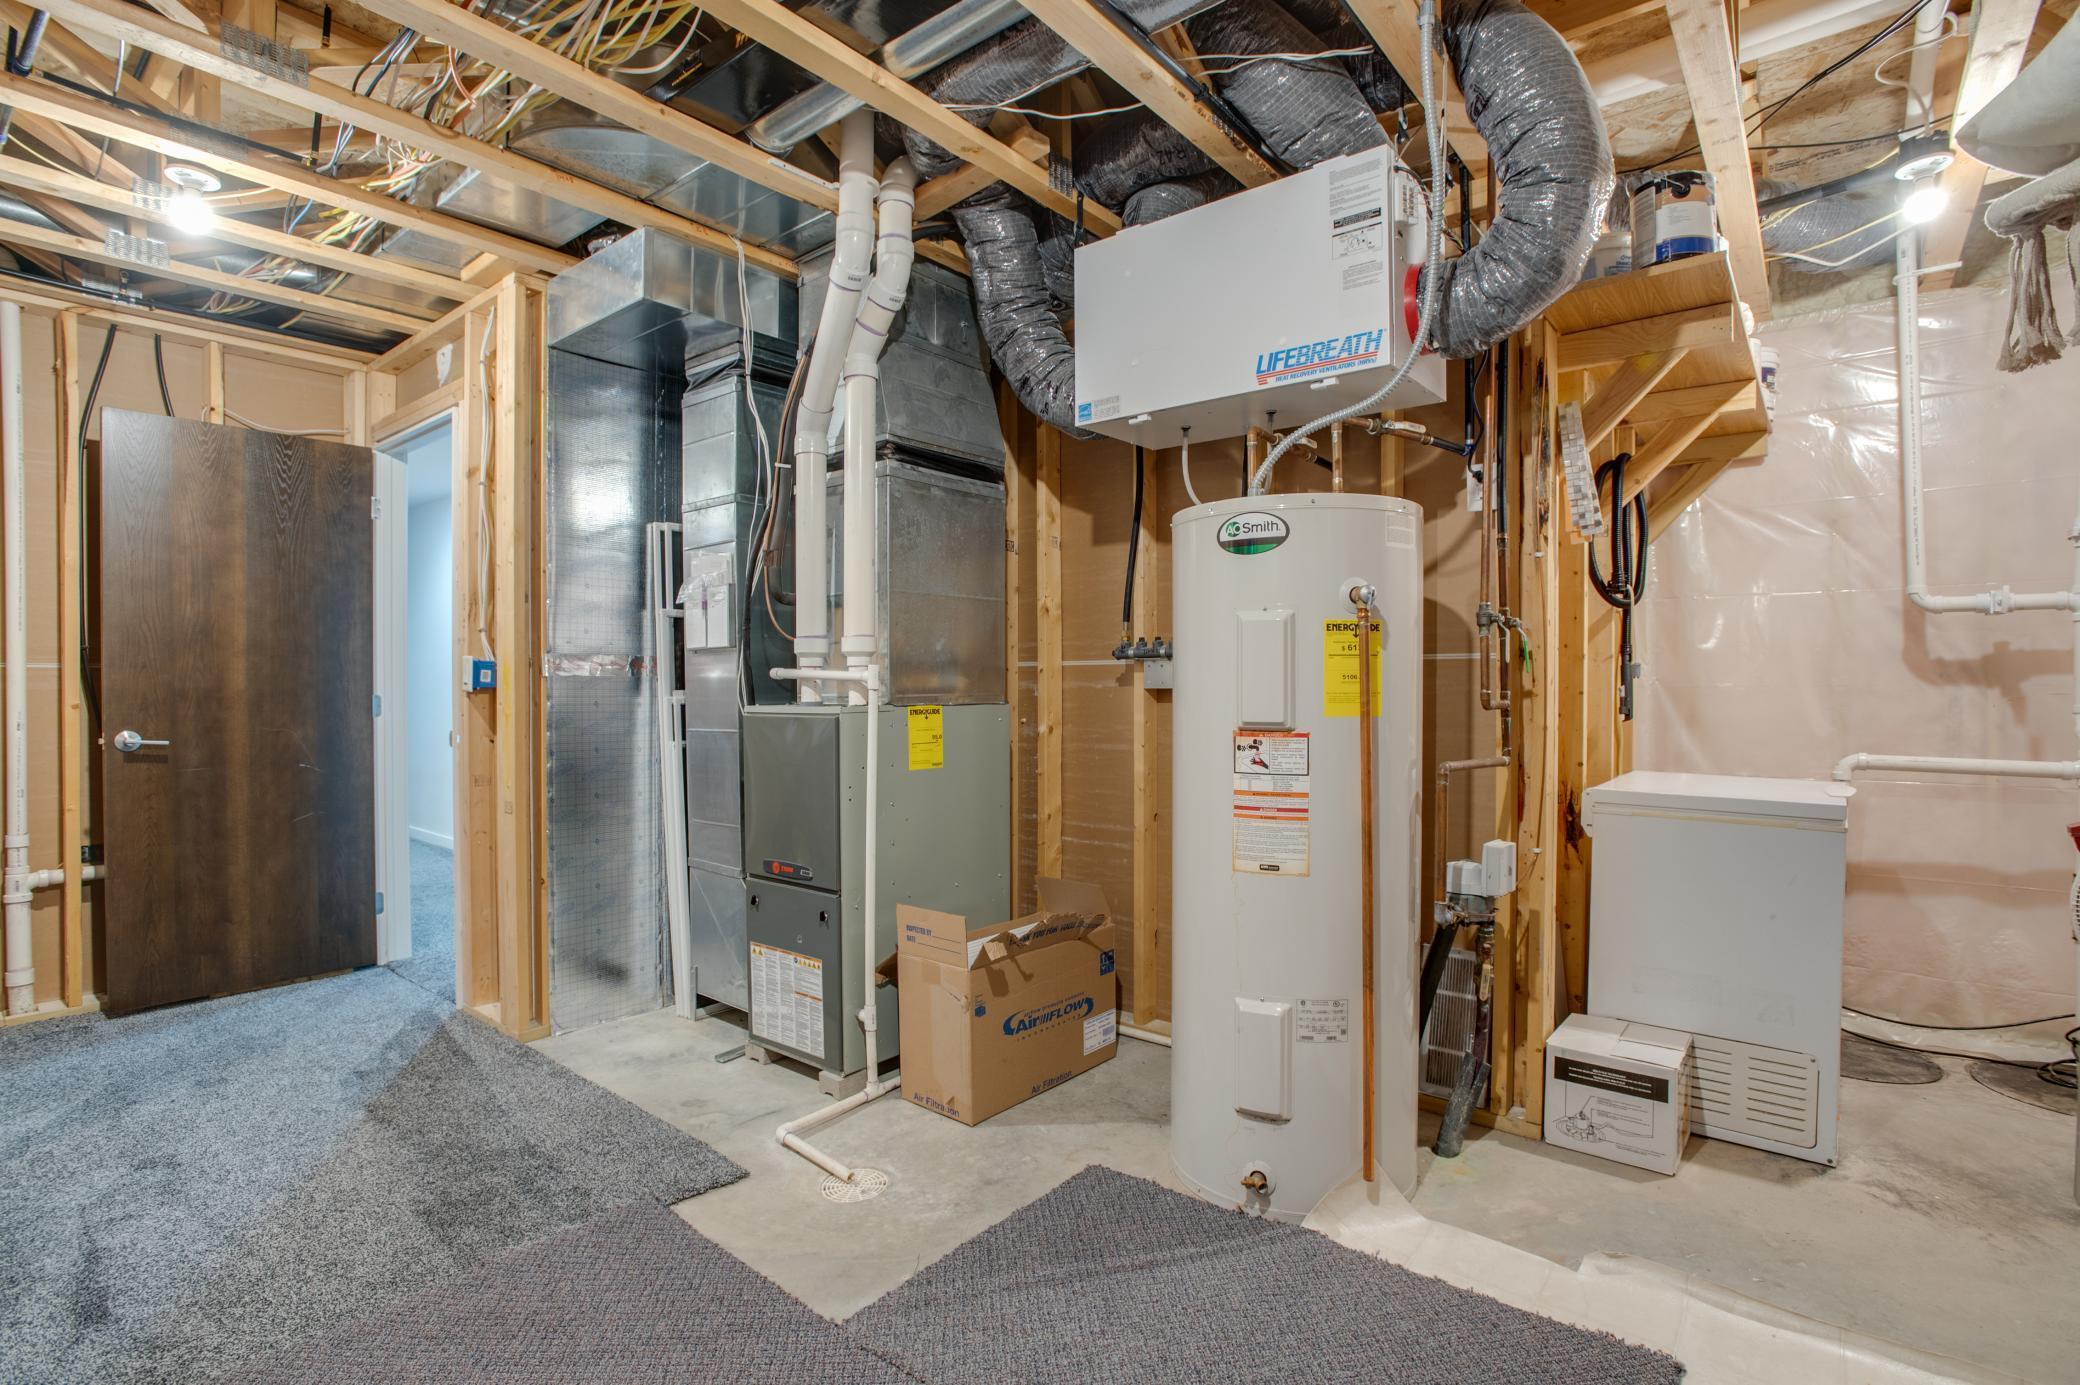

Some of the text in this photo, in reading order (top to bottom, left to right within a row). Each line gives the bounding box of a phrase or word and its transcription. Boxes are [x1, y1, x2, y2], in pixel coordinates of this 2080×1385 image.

[1255, 329, 1384, 375] LIFEBREATH
[1275, 374, 1289, 383] HEAT
[1290, 368, 1317, 380] RECOVERY
[1318, 361, 1356, 375] VENTILATORS
[1242, 520, 1279, 534] Smith
[1032, 1070, 1073, 1094] Air Filtration
[913, 1092, 924, 1104] Air
